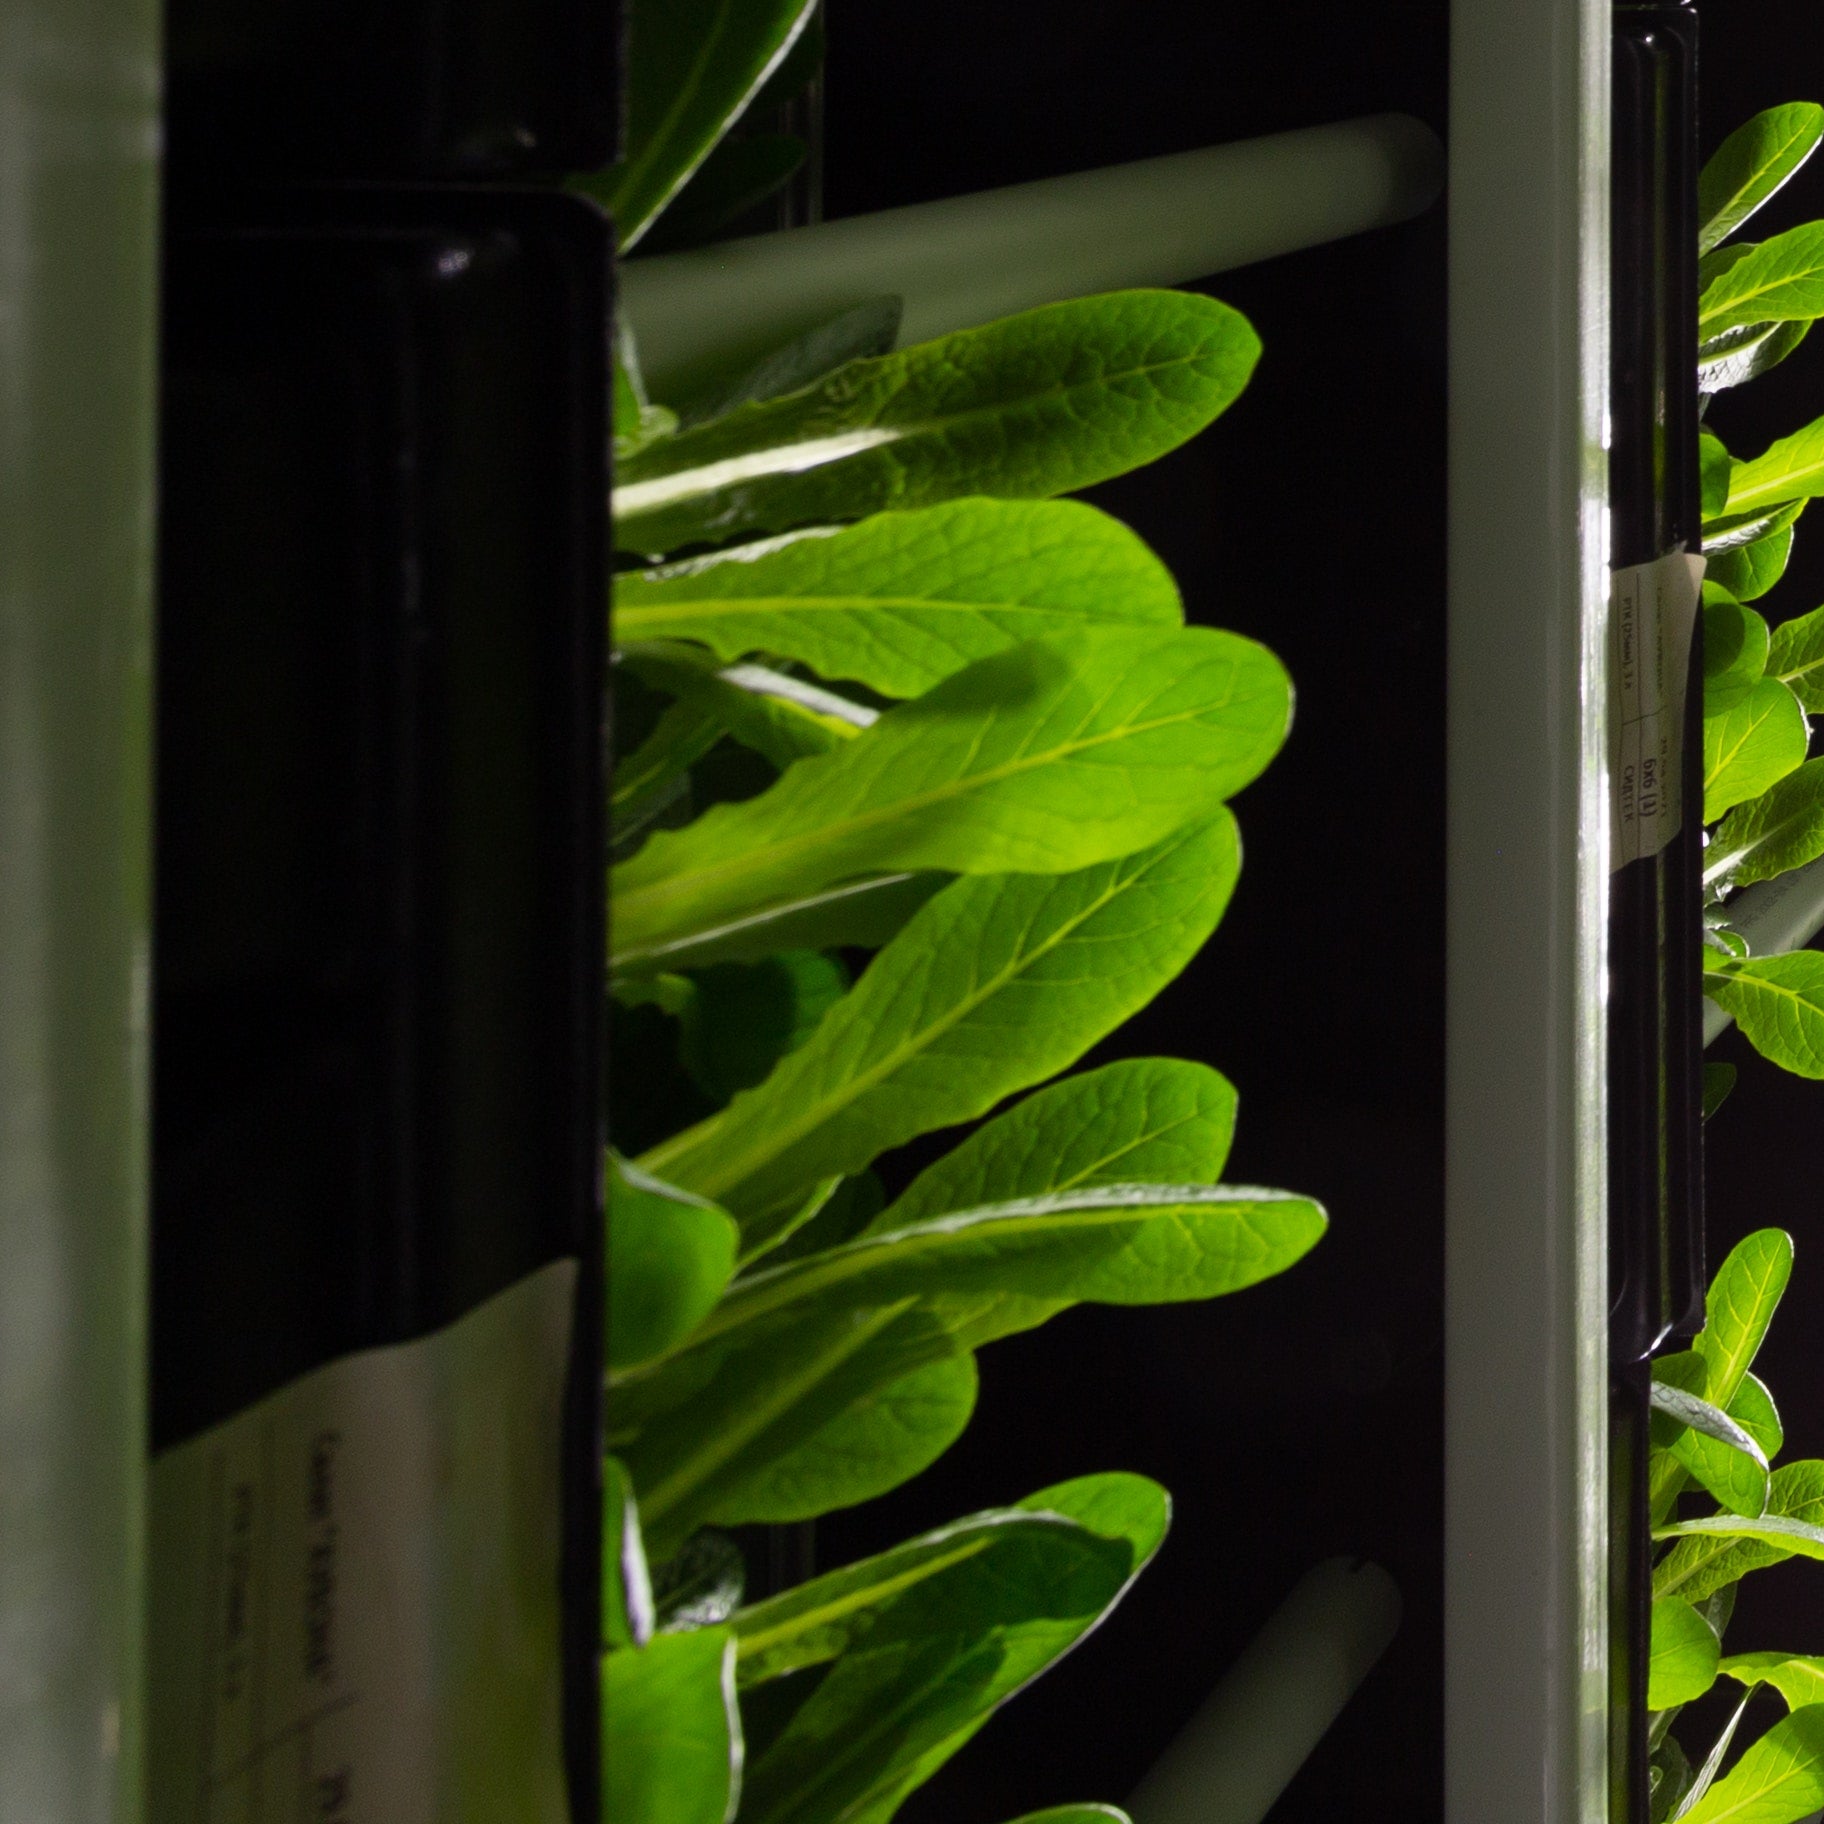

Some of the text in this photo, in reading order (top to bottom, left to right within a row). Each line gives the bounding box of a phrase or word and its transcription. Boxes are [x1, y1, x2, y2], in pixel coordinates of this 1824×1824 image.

[1621, 765, 1636, 823] СИДТЕК
[1638, 758, 1659, 818] 6x6 (1)
